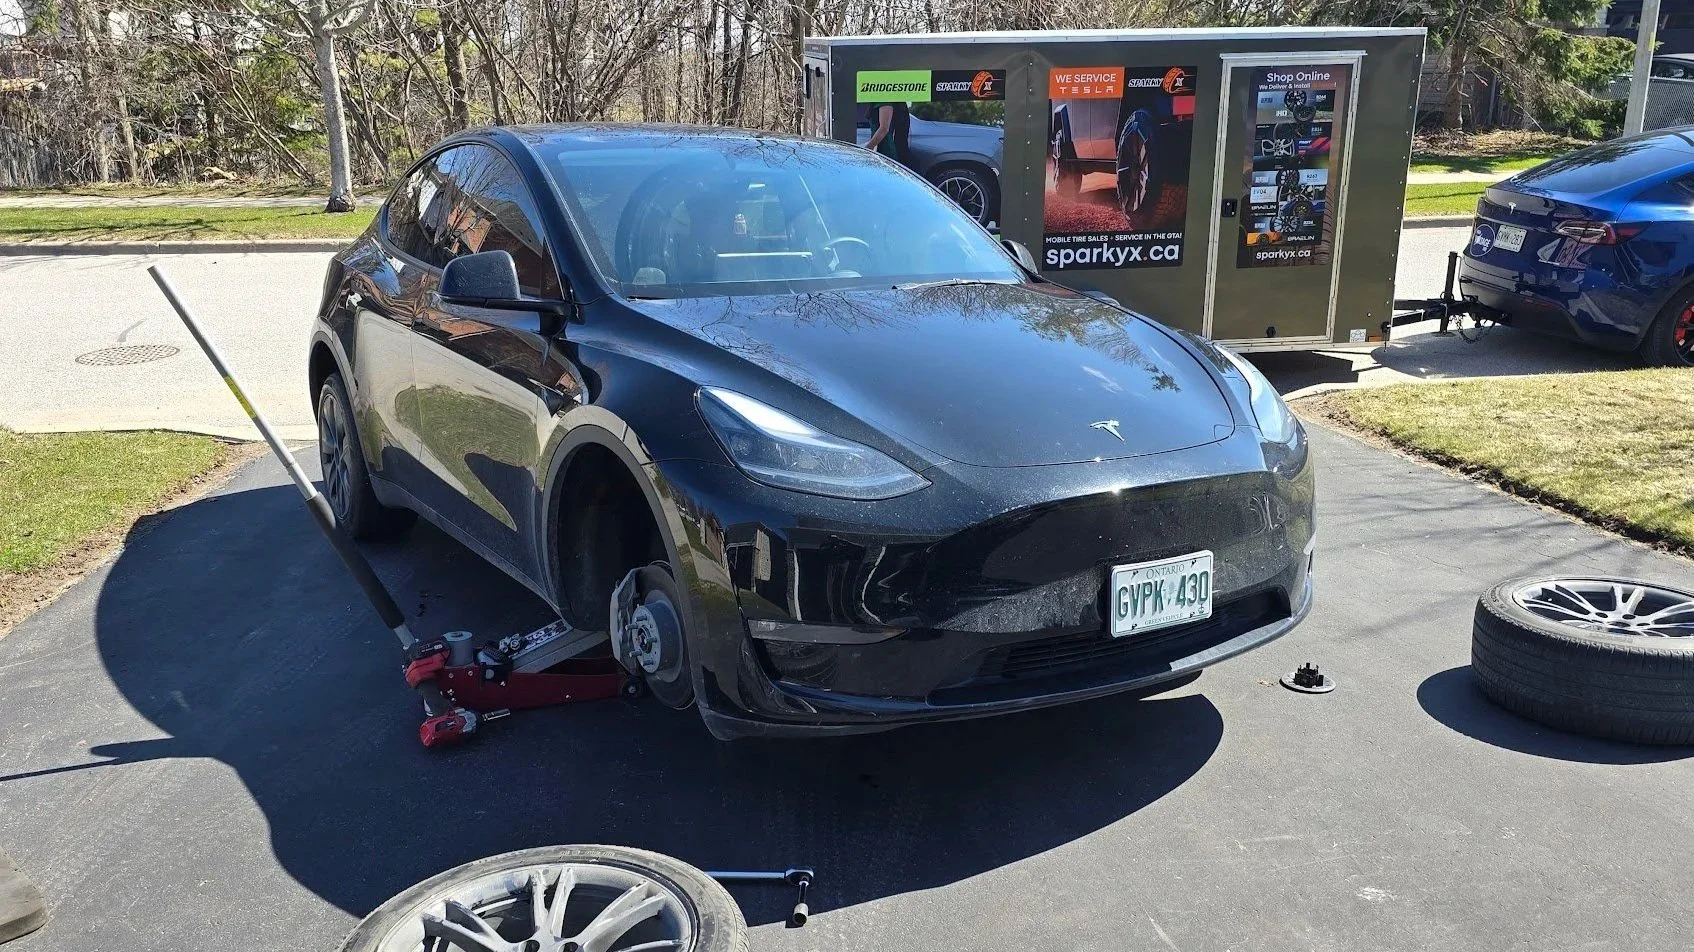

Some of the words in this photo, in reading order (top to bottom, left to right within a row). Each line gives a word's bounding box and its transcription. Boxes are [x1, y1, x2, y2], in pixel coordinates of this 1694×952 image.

[1055, 74, 1071, 83] WE
[1073, 73, 1116, 83] SERVICE
[1128, 77, 1162, 88] SPARKY
[1266, 72, 1293, 83] Shop
[1296, 71, 1330, 81] Online
[861, 83, 927, 92] BRIDGESTONE
[936, 82, 971, 91] SPARKY
[1059, 86, 1114, 94] TESLA
[1046, 243, 1179, 268] sparkyx.ca
[1146, 564, 1185, 580] ONTARIO
[1117, 579, 1165, 619] GVPK
[1175, 570, 1208, 607] 430
